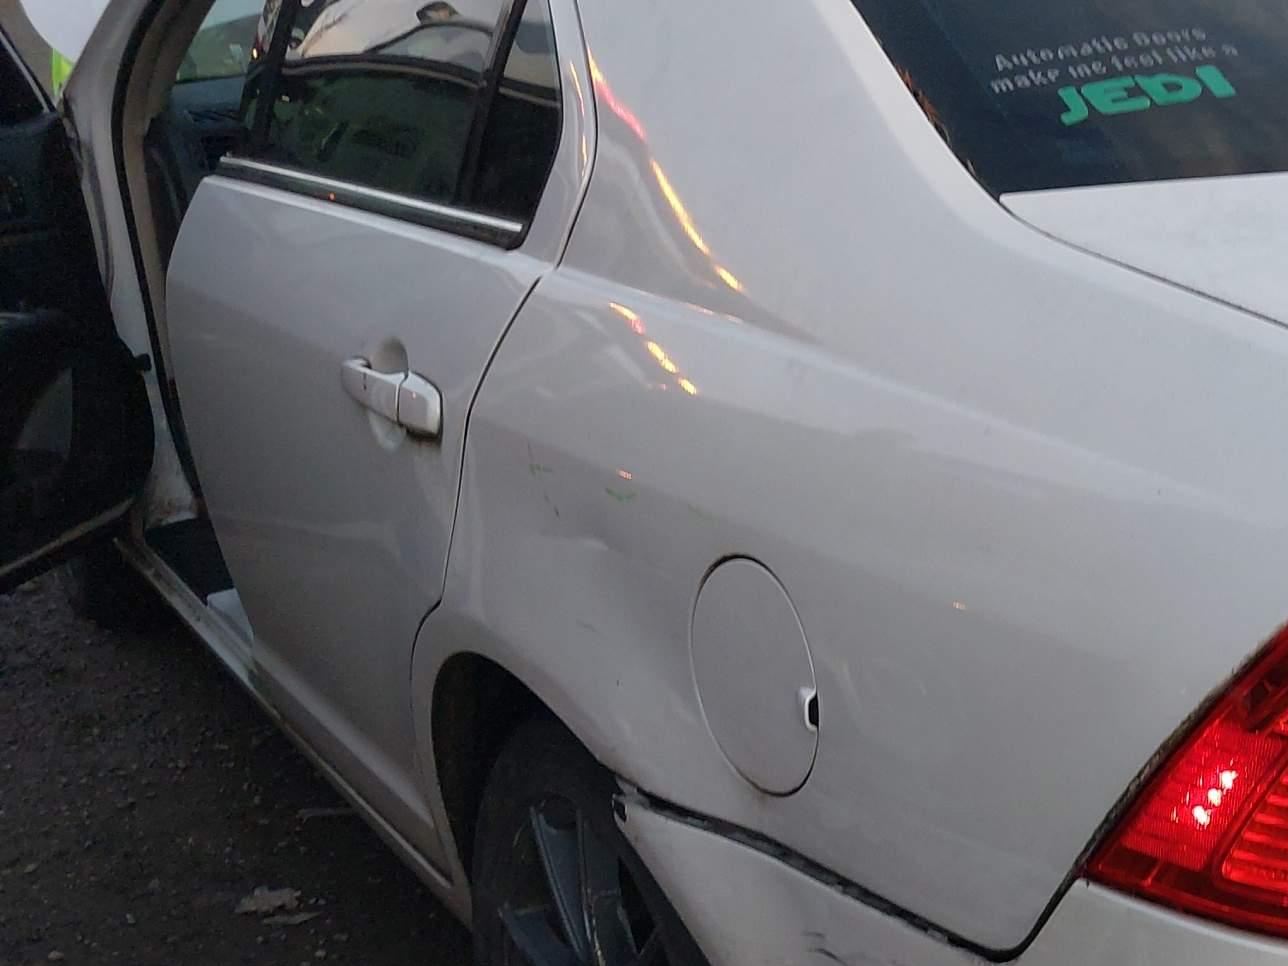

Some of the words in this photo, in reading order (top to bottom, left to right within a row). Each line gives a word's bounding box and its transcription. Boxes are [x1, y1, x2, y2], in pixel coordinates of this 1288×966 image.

[991, 68, 1060, 94] make
[1068, 60, 1107, 78] me
[1111, 48, 1162, 72] feel
[1166, 43, 1217, 63] like
[995, 36, 1128, 72] Automatic
[1057, 65, 1236, 126] JEDI
